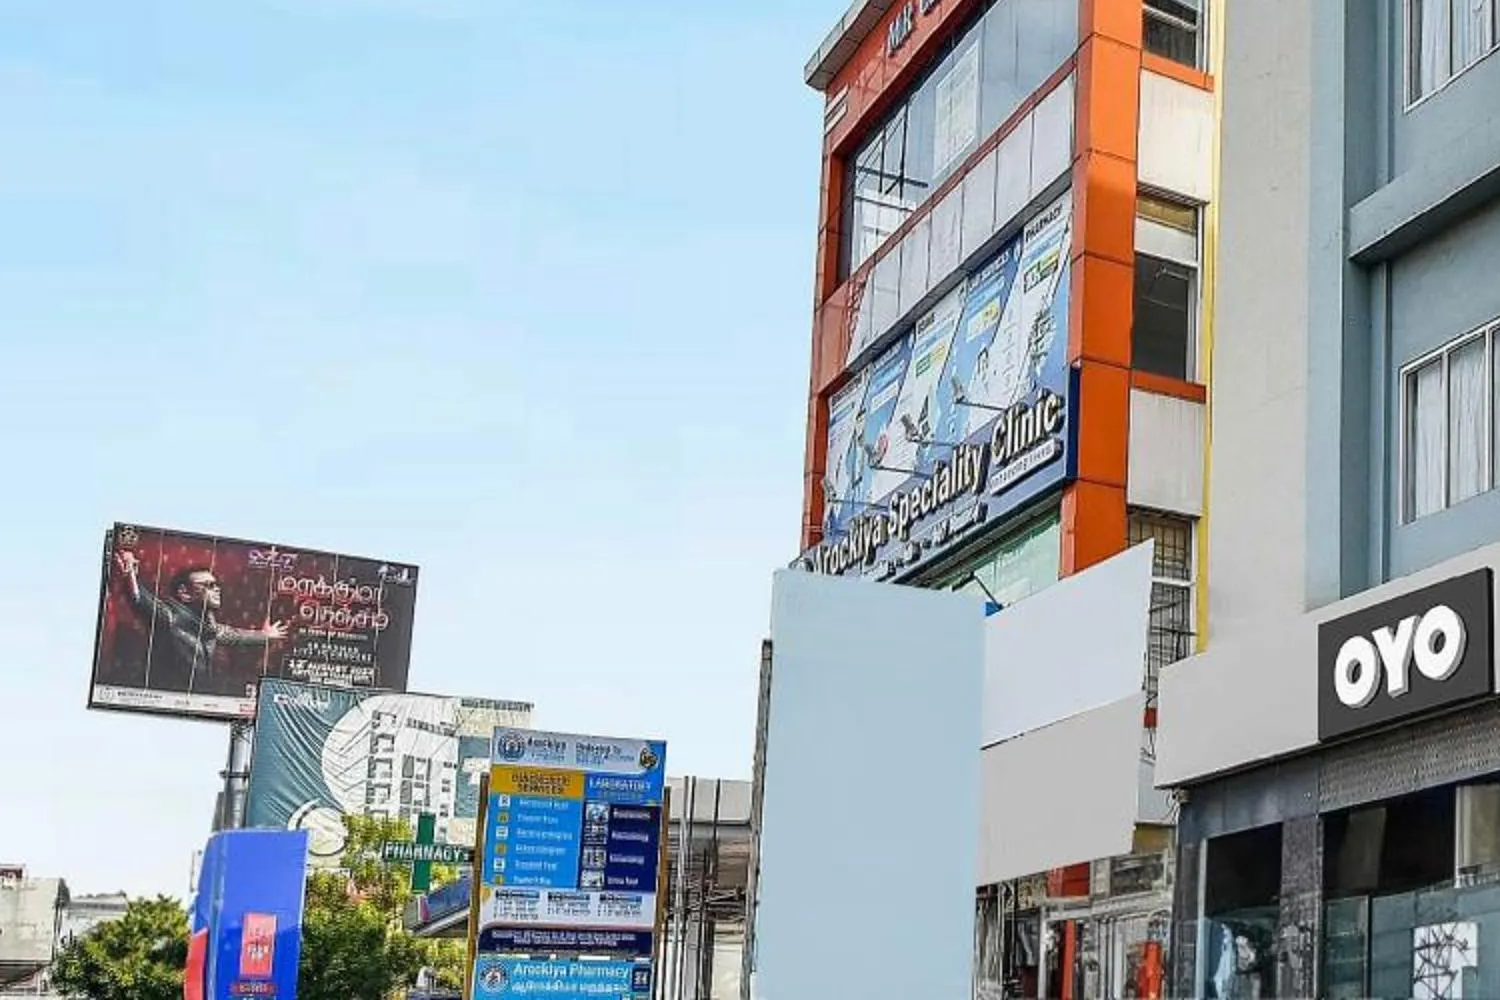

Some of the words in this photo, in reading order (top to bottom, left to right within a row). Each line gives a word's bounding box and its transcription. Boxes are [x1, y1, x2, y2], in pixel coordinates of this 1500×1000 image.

[887, 440, 984, 540] Speciality
[991, 388, 1058, 465] Clinic
[1334, 604, 1468, 710] OYO
[385, 841, 460, 862] PHARMACY
[569, 964, 630, 980] Pharmacy
